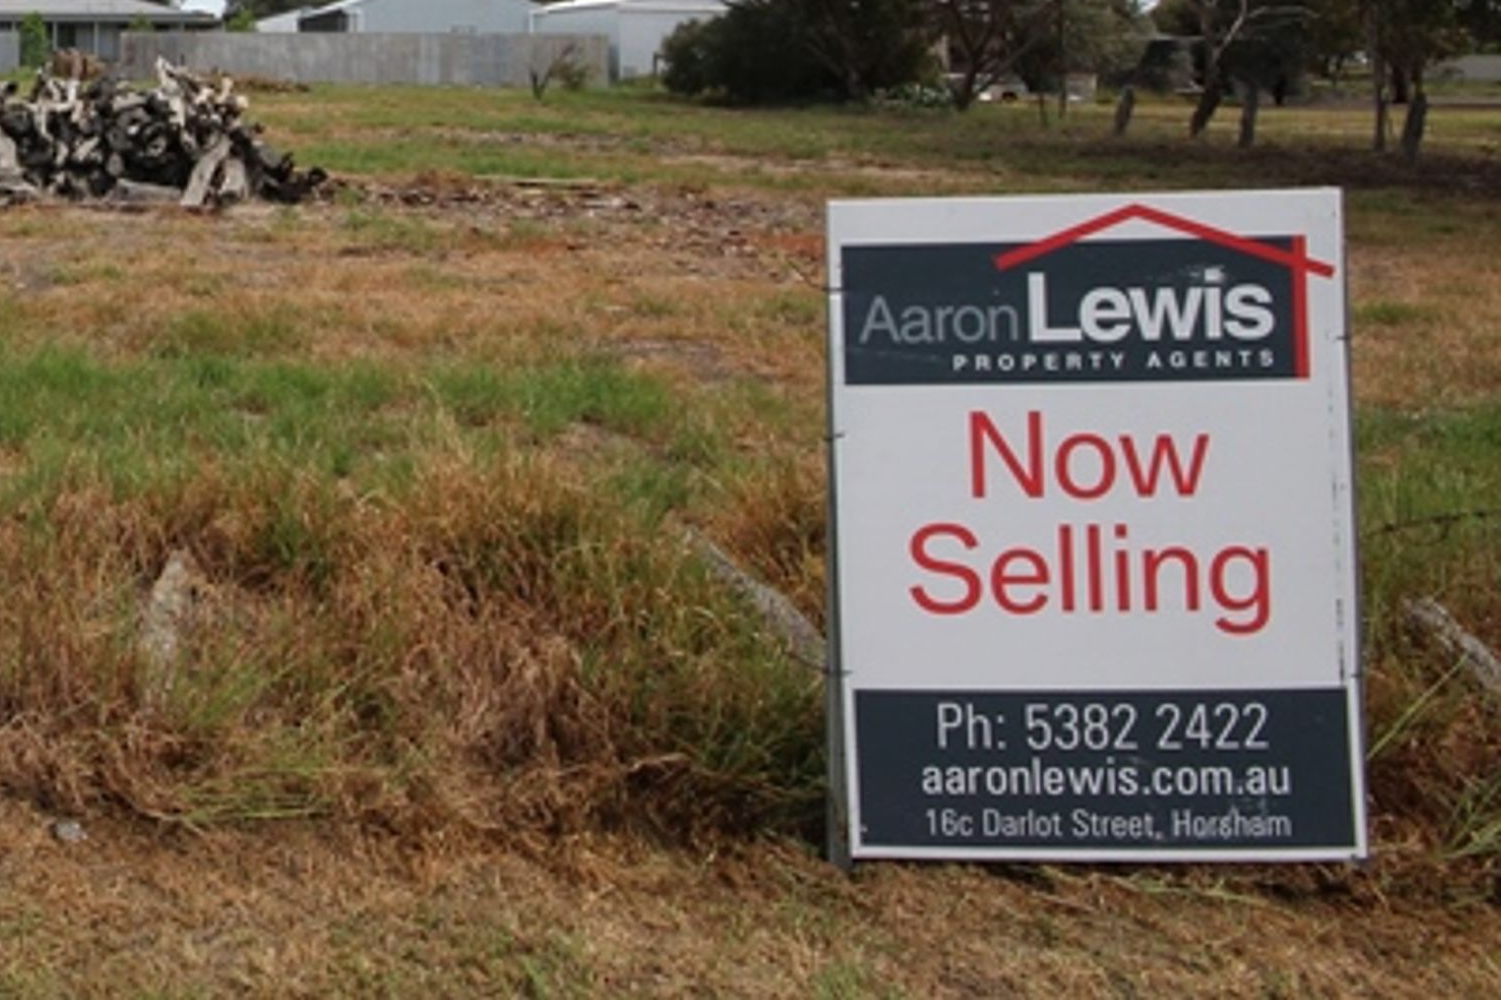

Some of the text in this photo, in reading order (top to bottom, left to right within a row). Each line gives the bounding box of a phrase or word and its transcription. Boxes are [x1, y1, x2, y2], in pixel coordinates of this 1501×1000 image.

[860, 270, 1275, 344] Aaron Lewis
[953, 348, 1275, 371] PROPERTY AGENTS
[968, 410, 1210, 499] Now
[909, 523, 1270, 634] Selling
[936, 701, 1269, 750] Ph: 5382 2422
[922, 758, 1290, 796] aaronlewis.com.au
[926, 808, 1292, 840] 16c Darlot Street, Horsham
